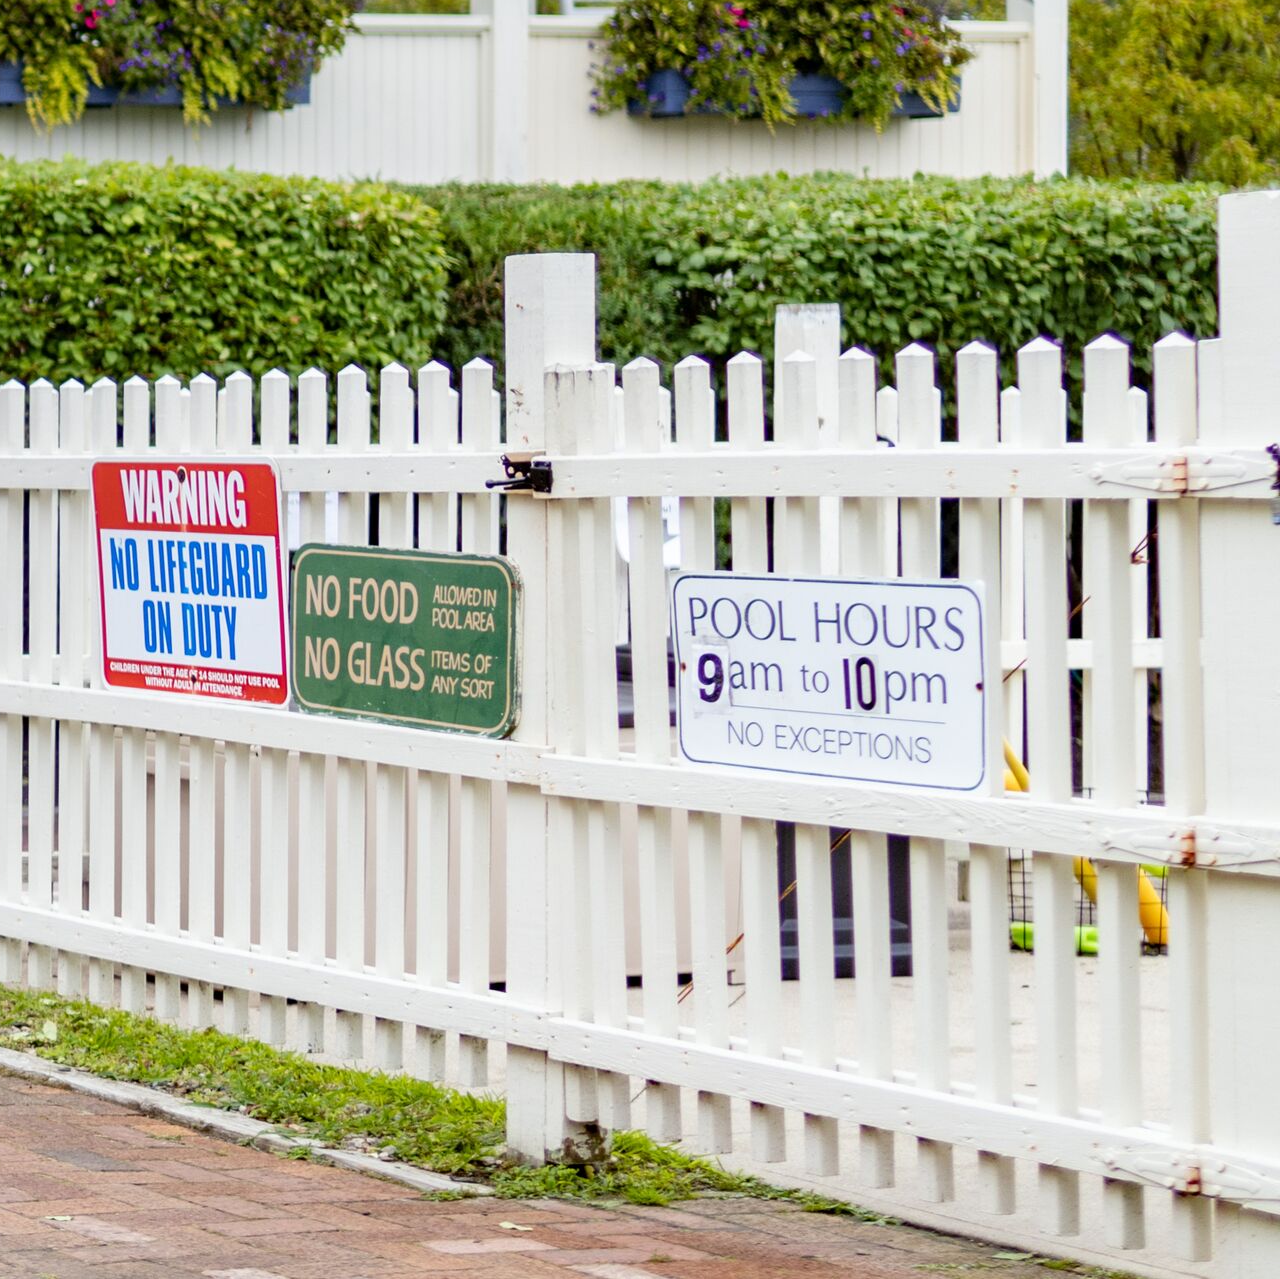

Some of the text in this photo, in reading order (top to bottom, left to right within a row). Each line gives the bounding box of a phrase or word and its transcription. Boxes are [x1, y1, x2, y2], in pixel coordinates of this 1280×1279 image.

[119, 468, 247, 528] WARNING
[109, 537, 268, 600] NO LIFEGUARD
[305, 574, 419, 624] NO FOOD
[432, 585, 497, 608] ALLOWED IN
[432, 608, 495, 632] POOL AREA
[142, 599, 237, 660] ON DUTY
[688, 597, 965, 652] POOL HOURS
[109, 661, 140, 674] CHILDREN
[140, 665, 162, 676] UNDER
[162, 667, 175, 677] THE
[175, 668, 189, 678] AGE
[199, 670, 207, 680] 14
[208, 671, 233, 683] SHOULD
[233, 674, 247, 685] NOT
[248, 675, 262, 686] USE
[262, 677, 280, 688] POOL
[304, 635, 426, 691] NO GLASS
[431, 650, 492, 674] ITEMS OF
[697, 652, 948, 714] 9am to 10pm
[145, 677, 173, 689] WITHOUT
[173, 679, 193, 690] ADULT
[202, 682, 242, 696] ATTENDANCE
[431, 675, 495, 699] ANY SORT
[728, 720, 933, 764] NO EXCEPTIONS
